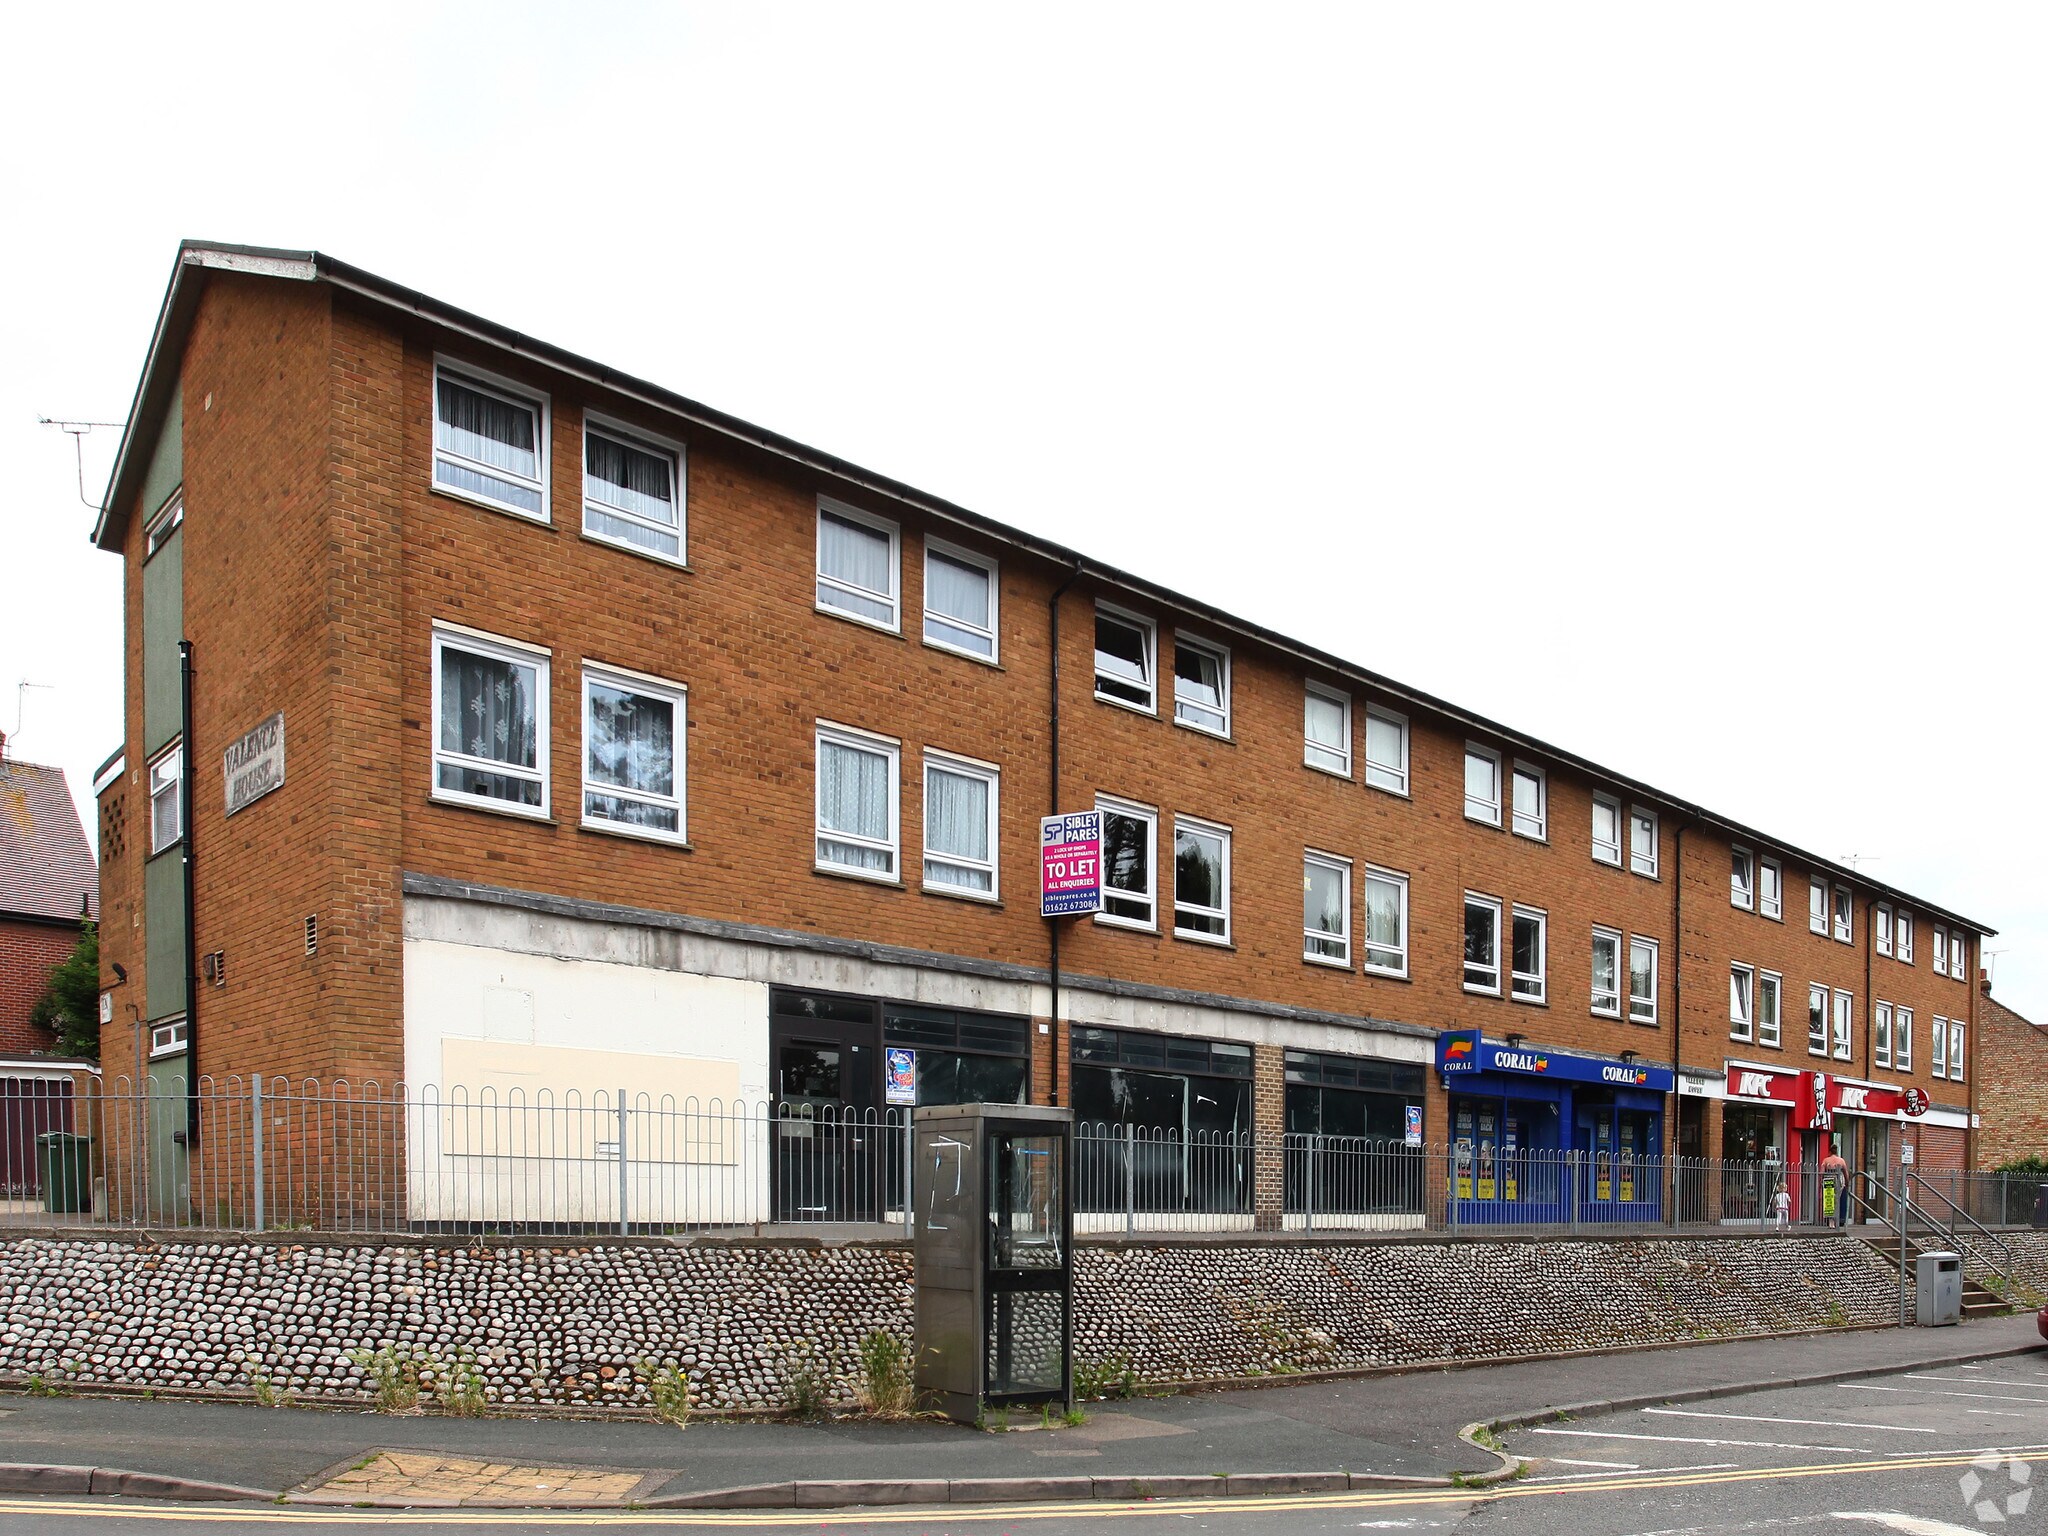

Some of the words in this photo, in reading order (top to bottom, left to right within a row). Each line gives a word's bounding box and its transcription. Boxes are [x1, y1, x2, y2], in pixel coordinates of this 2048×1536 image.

[226, 727, 278, 776] VALENCE
[233, 760, 272, 805] HOUSE
[1065, 814, 1098, 829] SIBLEY
[1065, 828, 1098, 843] PARES
[1046, 862, 1066, 879] TO
[1070, 859, 1096, 877] LET
[1048, 881, 1059, 889] ALL
[1060, 878, 1095, 889] ENQUIRIES
[1045, 891, 1097, 902] sibleypares.co.uk
[1045, 903, 1068, 912] 01622
[1069, 899, 1098, 909] 673086
[1444, 1061, 1473, 1071] CORAL
[1494, 1051, 1534, 1071] CORAL
[1602, 1066, 1635, 1084] CORAL
[1739, 1072, 1774, 1097] KFC
[1841, 1087, 1870, 1109] KFC
